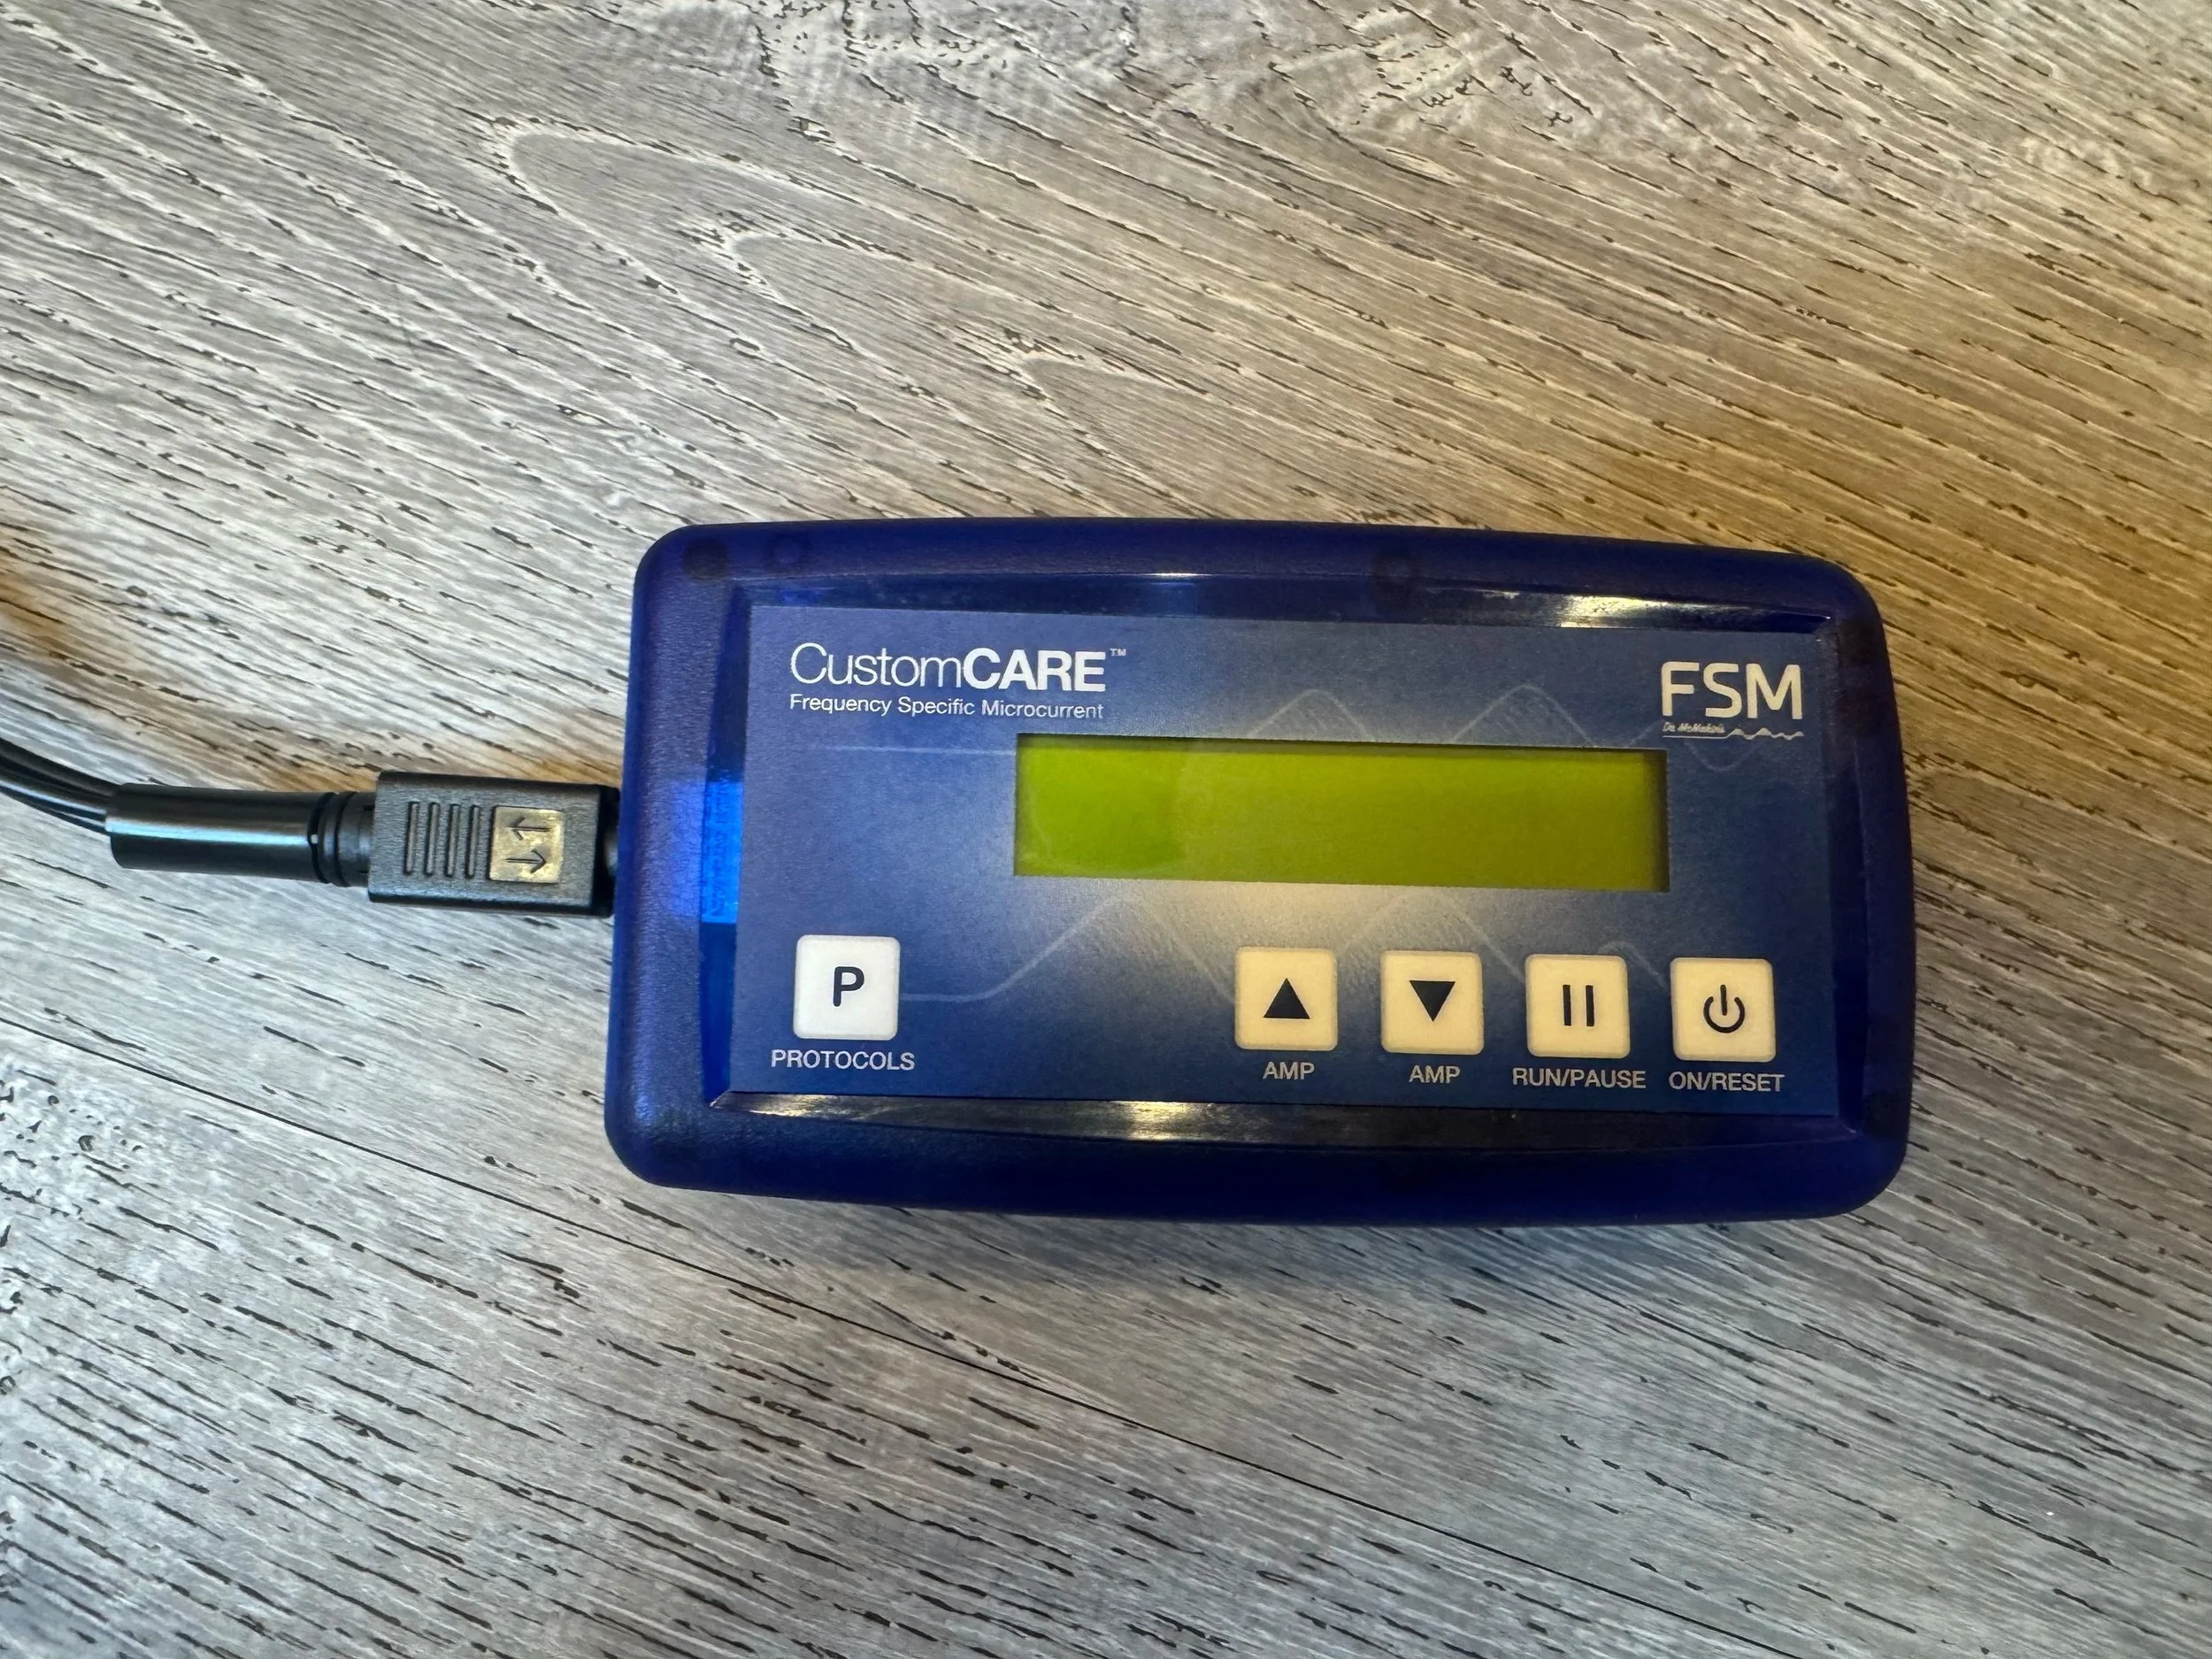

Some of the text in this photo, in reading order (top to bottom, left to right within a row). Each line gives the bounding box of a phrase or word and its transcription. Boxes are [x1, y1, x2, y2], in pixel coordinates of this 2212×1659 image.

[1661, 661, 1803, 719] FSM
[790, 693, 1104, 719] Frequency Specific Microcurrent
[833, 965, 865, 1007] P
[771, 1048, 916, 1071] PROTOCOLS
[1263, 1061, 1316, 1080] AMP
[1409, 1064, 1461, 1084] AMP
[1512, 1067, 1647, 1089] RUN/PAUSE
[1669, 1071, 1786, 1092] ON/RESET
